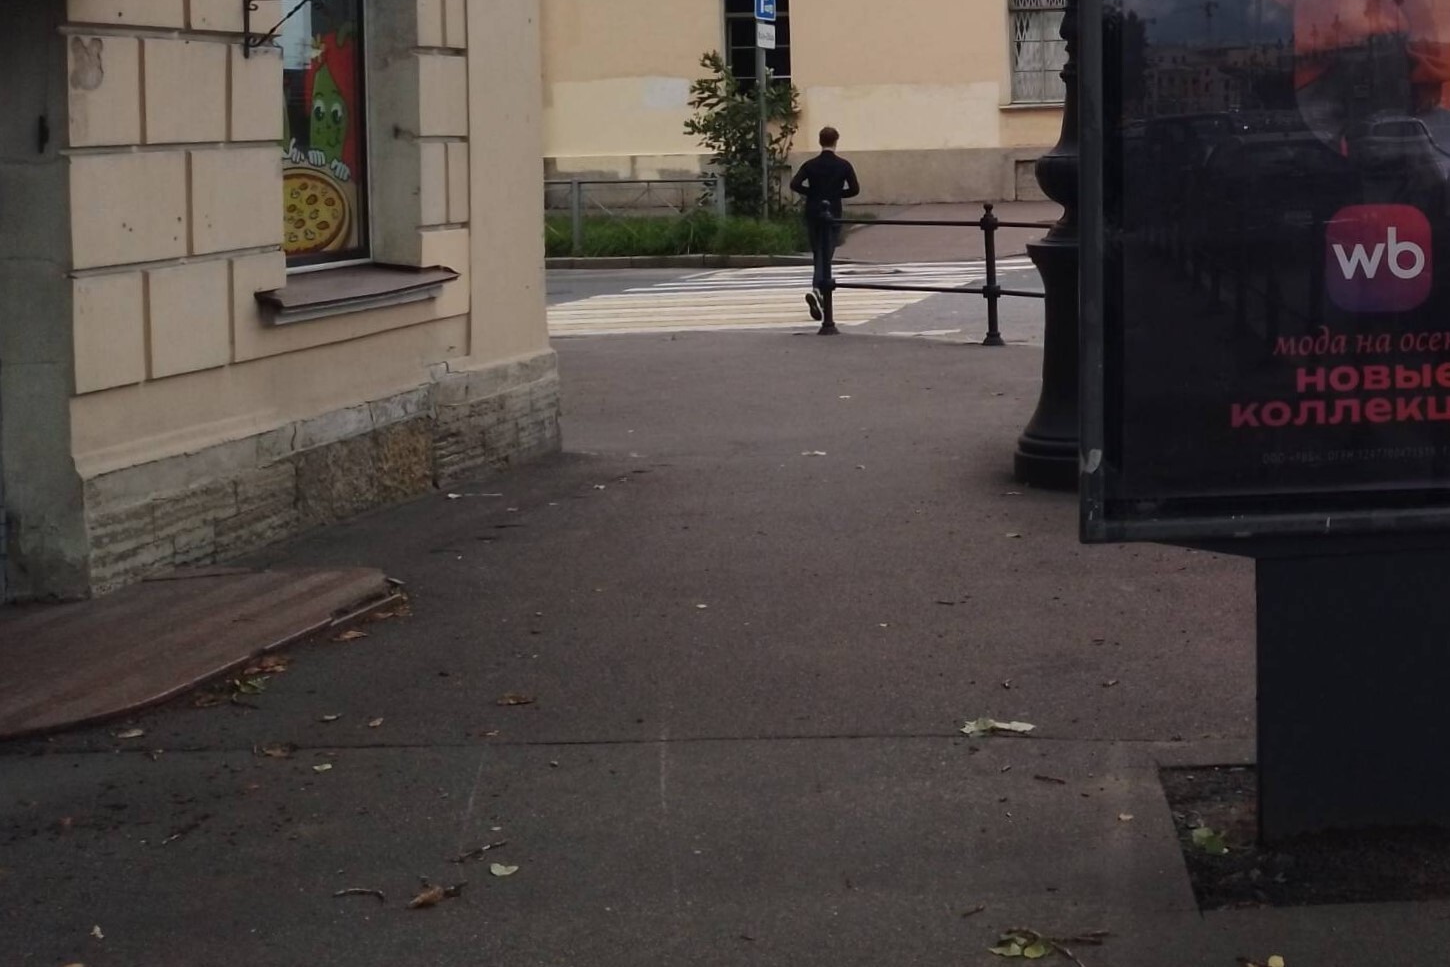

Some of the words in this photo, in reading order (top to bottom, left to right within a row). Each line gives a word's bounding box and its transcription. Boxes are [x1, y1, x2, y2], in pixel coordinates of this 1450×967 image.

[1331, 226, 1426, 280] wb
[1273, 326, 1346, 356] мода
[1356, 332, 1392, 354] на
